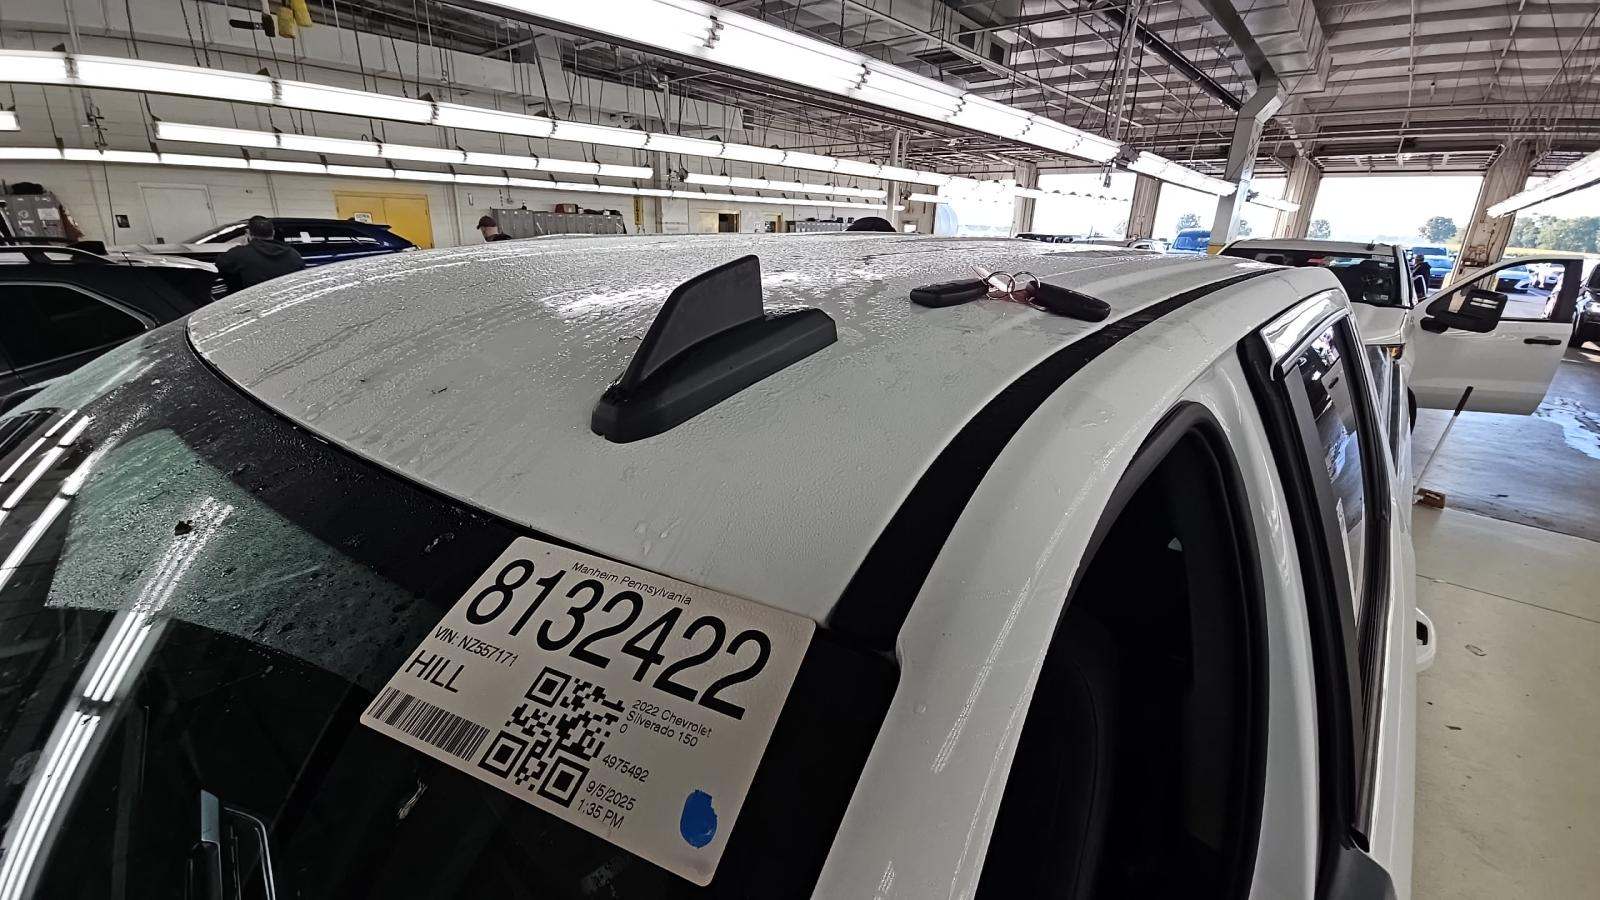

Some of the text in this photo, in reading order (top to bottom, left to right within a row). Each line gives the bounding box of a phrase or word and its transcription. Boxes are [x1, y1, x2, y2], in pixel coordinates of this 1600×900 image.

[571, 561, 692, 606] Manheim Pennsylvania
[434, 626, 519, 668] VIN: NZ557171
[465, 558, 772, 721] 8132422
[405, 649, 465, 693] HILL
[626, 710, 698, 747] Silverado 150
[632, 699, 712, 738] 2022 Chevrolet
[602, 754, 649, 782] 4975492
[577, 799, 625, 829] 1:35 PM
[585, 780, 636, 811] 9/5/2025
